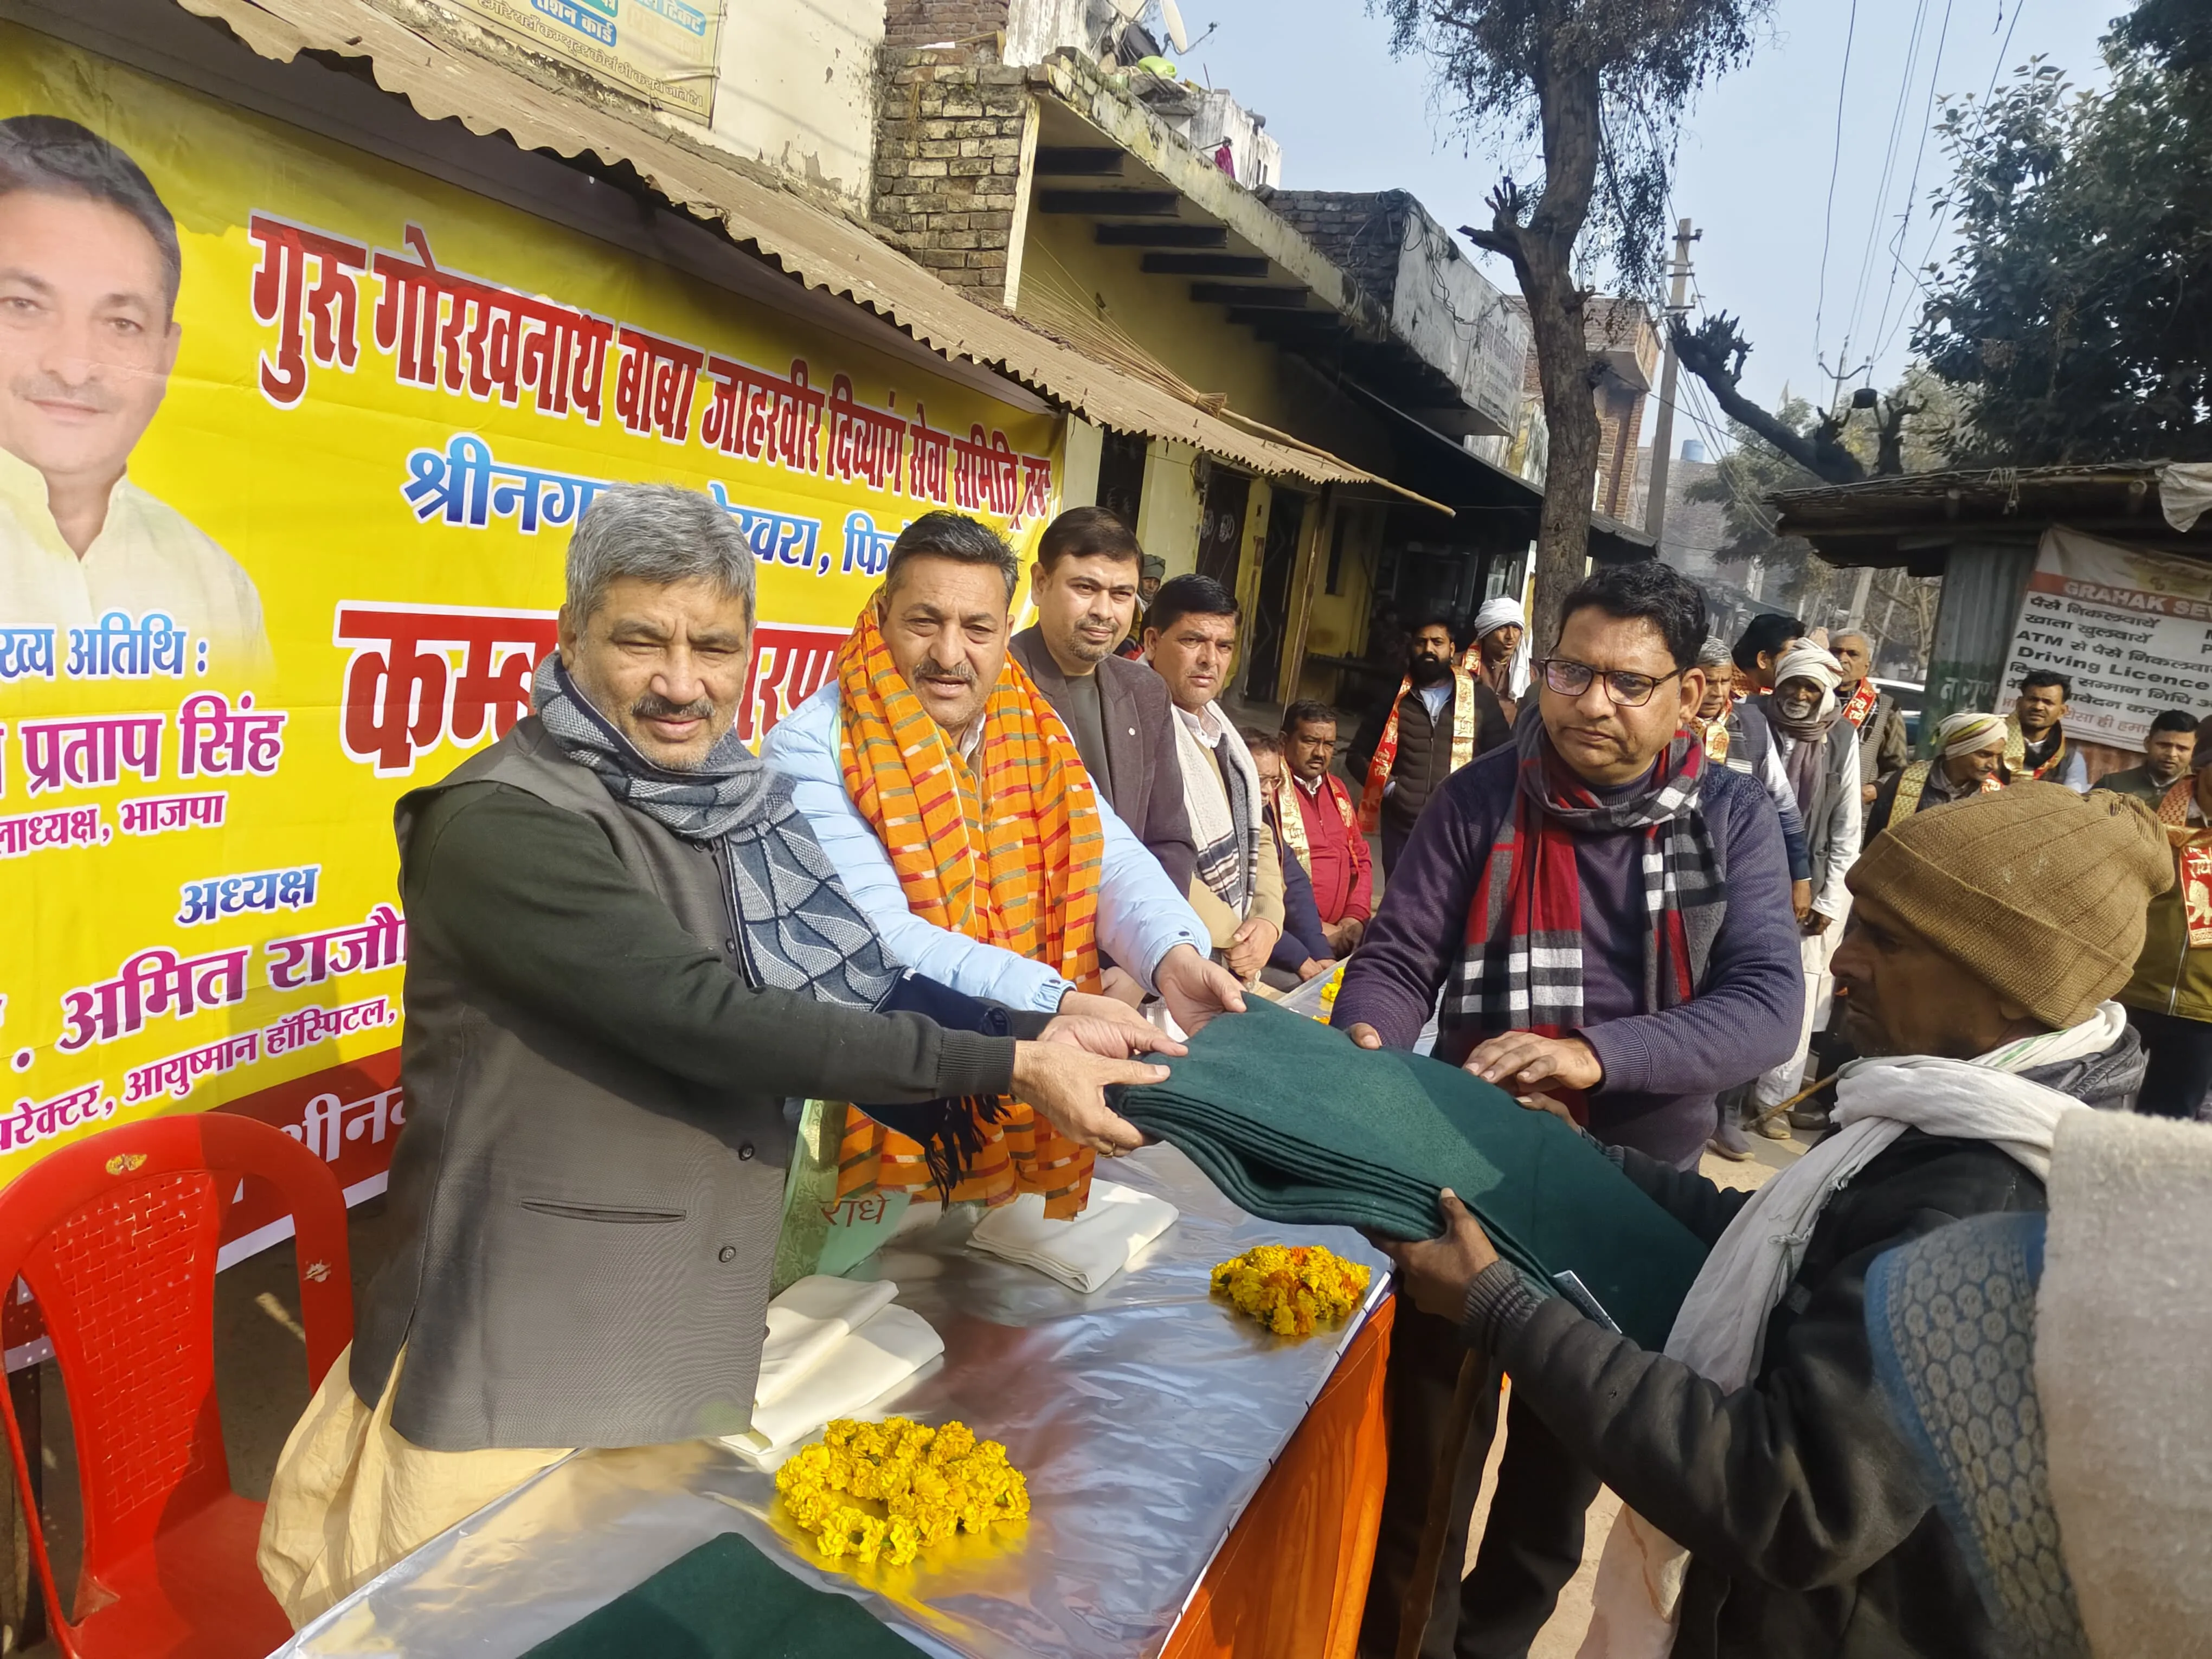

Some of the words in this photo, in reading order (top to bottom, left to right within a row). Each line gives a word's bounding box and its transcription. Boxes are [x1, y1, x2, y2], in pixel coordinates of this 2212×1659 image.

[581, 14, 613, 43] कार्ड
[374, 224, 613, 421] गोरखनाथ
[616, 326, 704, 441] बाबा
[703, 359, 825, 472] जाहरवीर
[826, 373, 906, 492] दिव्यांग
[910, 402, 950, 503] सेवा
[2063, 581, 2168, 612] GRAHAK
[0, 629, 54, 678] ख्य
[67, 612, 187, 675] अतिथि
[2016, 630, 2063, 647] ATM
[339, 610, 558, 769] कम्ब
[737, 628, 852, 741] रण
[2017, 646, 2101, 675] Driving
[2109, 664, 2210, 690] Licence
[22, 719, 163, 793] प्रताप
[179, 695, 286, 774] सिंह
[121, 795, 225, 832] भाजपा
[178, 868, 319, 923] अध्यक्ष
[60, 950, 248, 1050] अमित
[269, 906, 407, 988] राजौ
[125, 1033, 256, 1095] आयुष्मान
[267, 999, 396, 1054] हॉस्पिटल,
[819, 1194, 891, 1227] राधे
